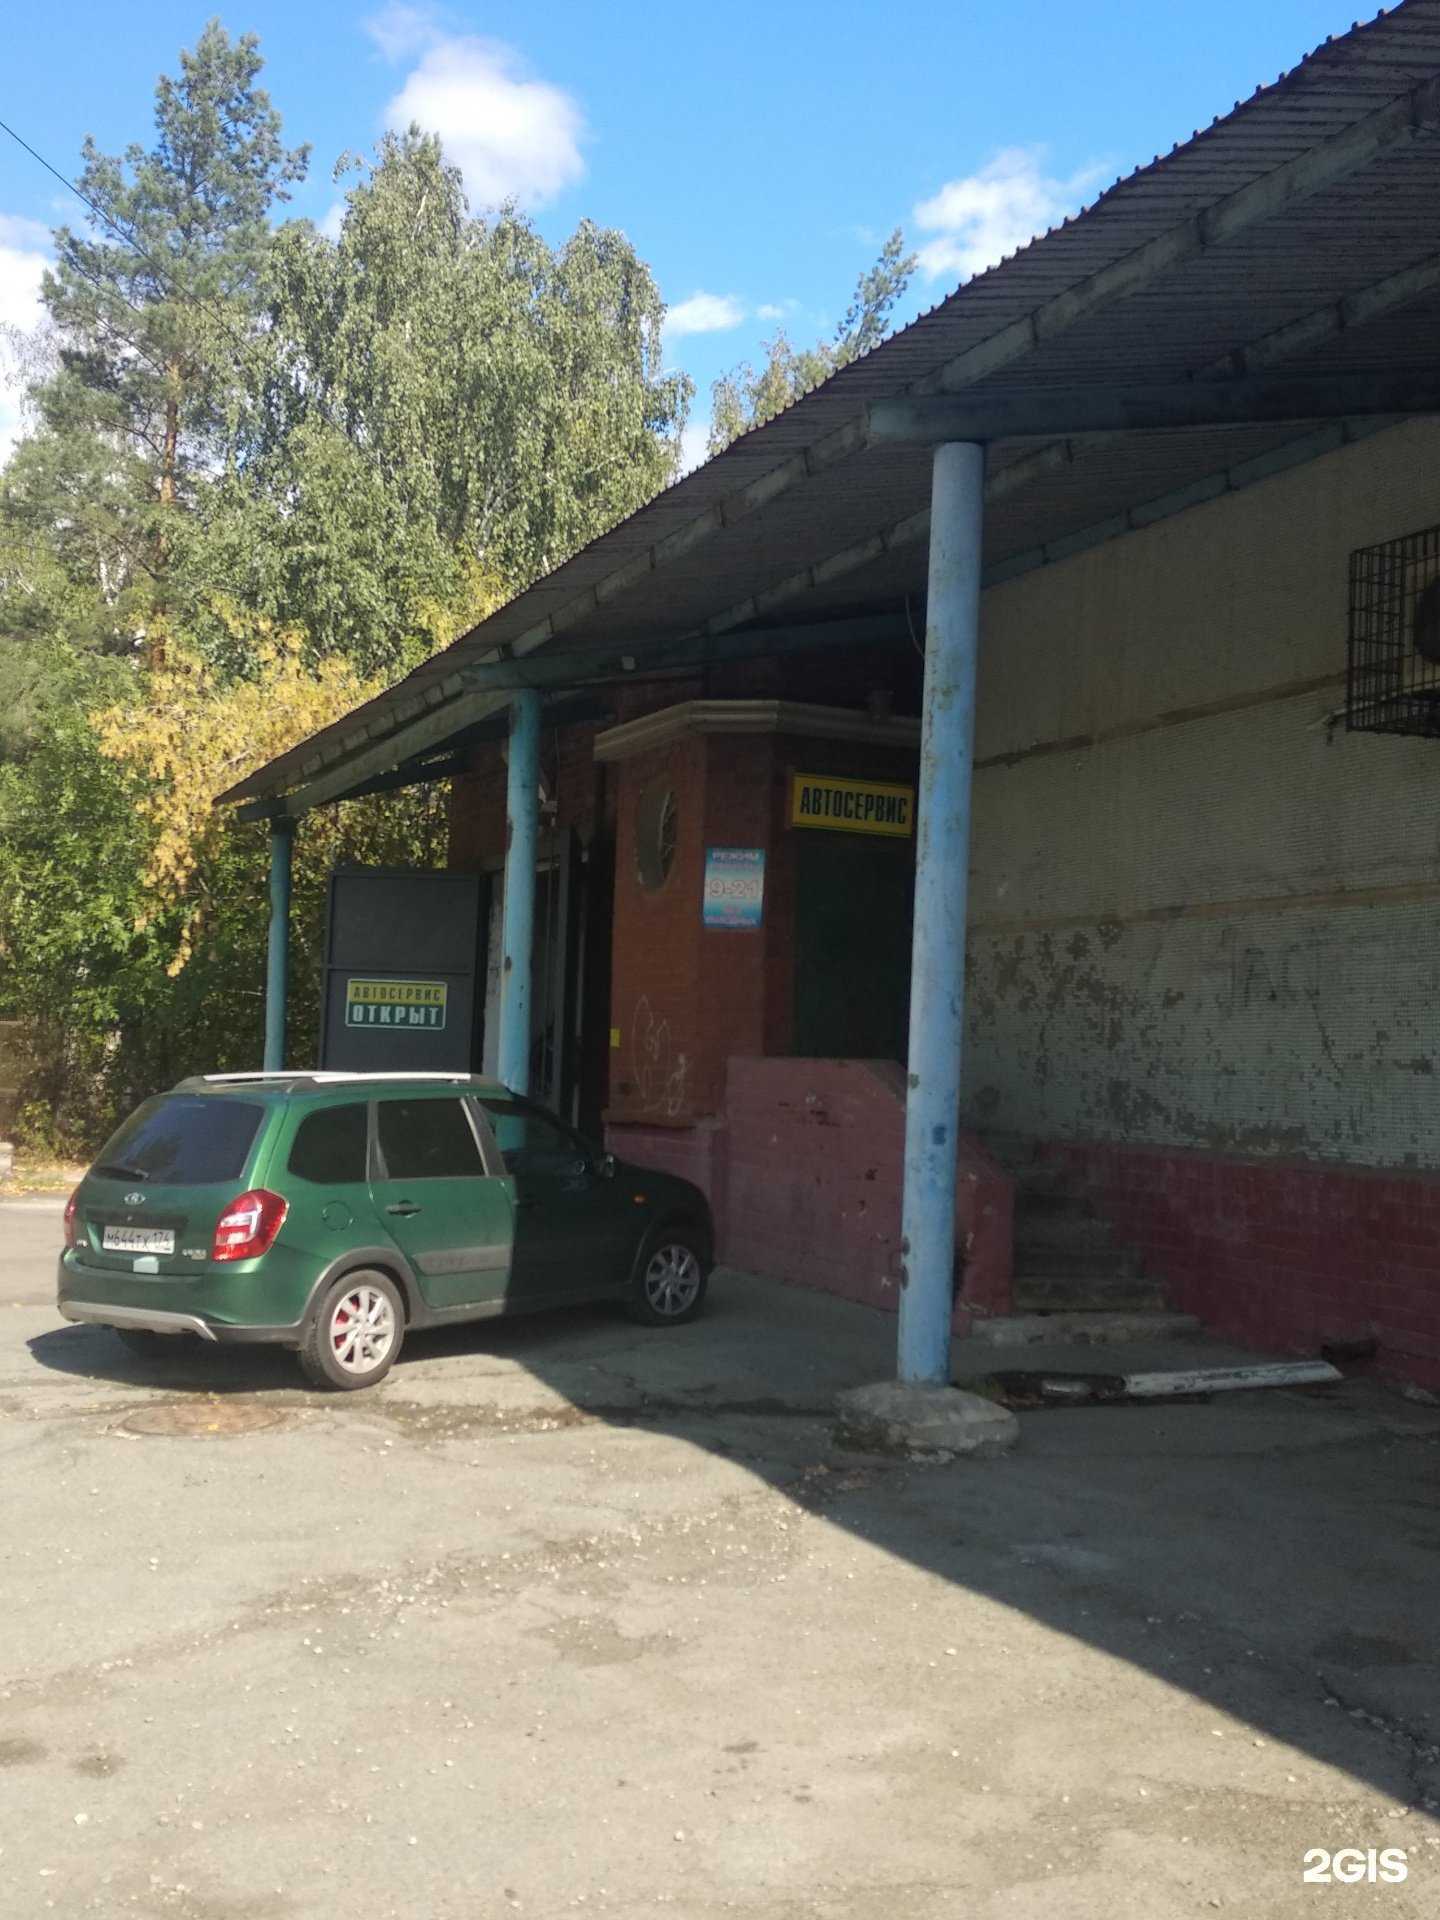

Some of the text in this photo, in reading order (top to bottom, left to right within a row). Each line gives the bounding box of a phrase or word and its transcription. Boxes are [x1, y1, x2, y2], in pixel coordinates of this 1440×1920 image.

[800, 786, 908, 824] АВТОСЕРВИС
[353, 986, 441, 1002] АВТОСЕРВИС
[352, 1004, 440, 1025] ОТКРЫТ
